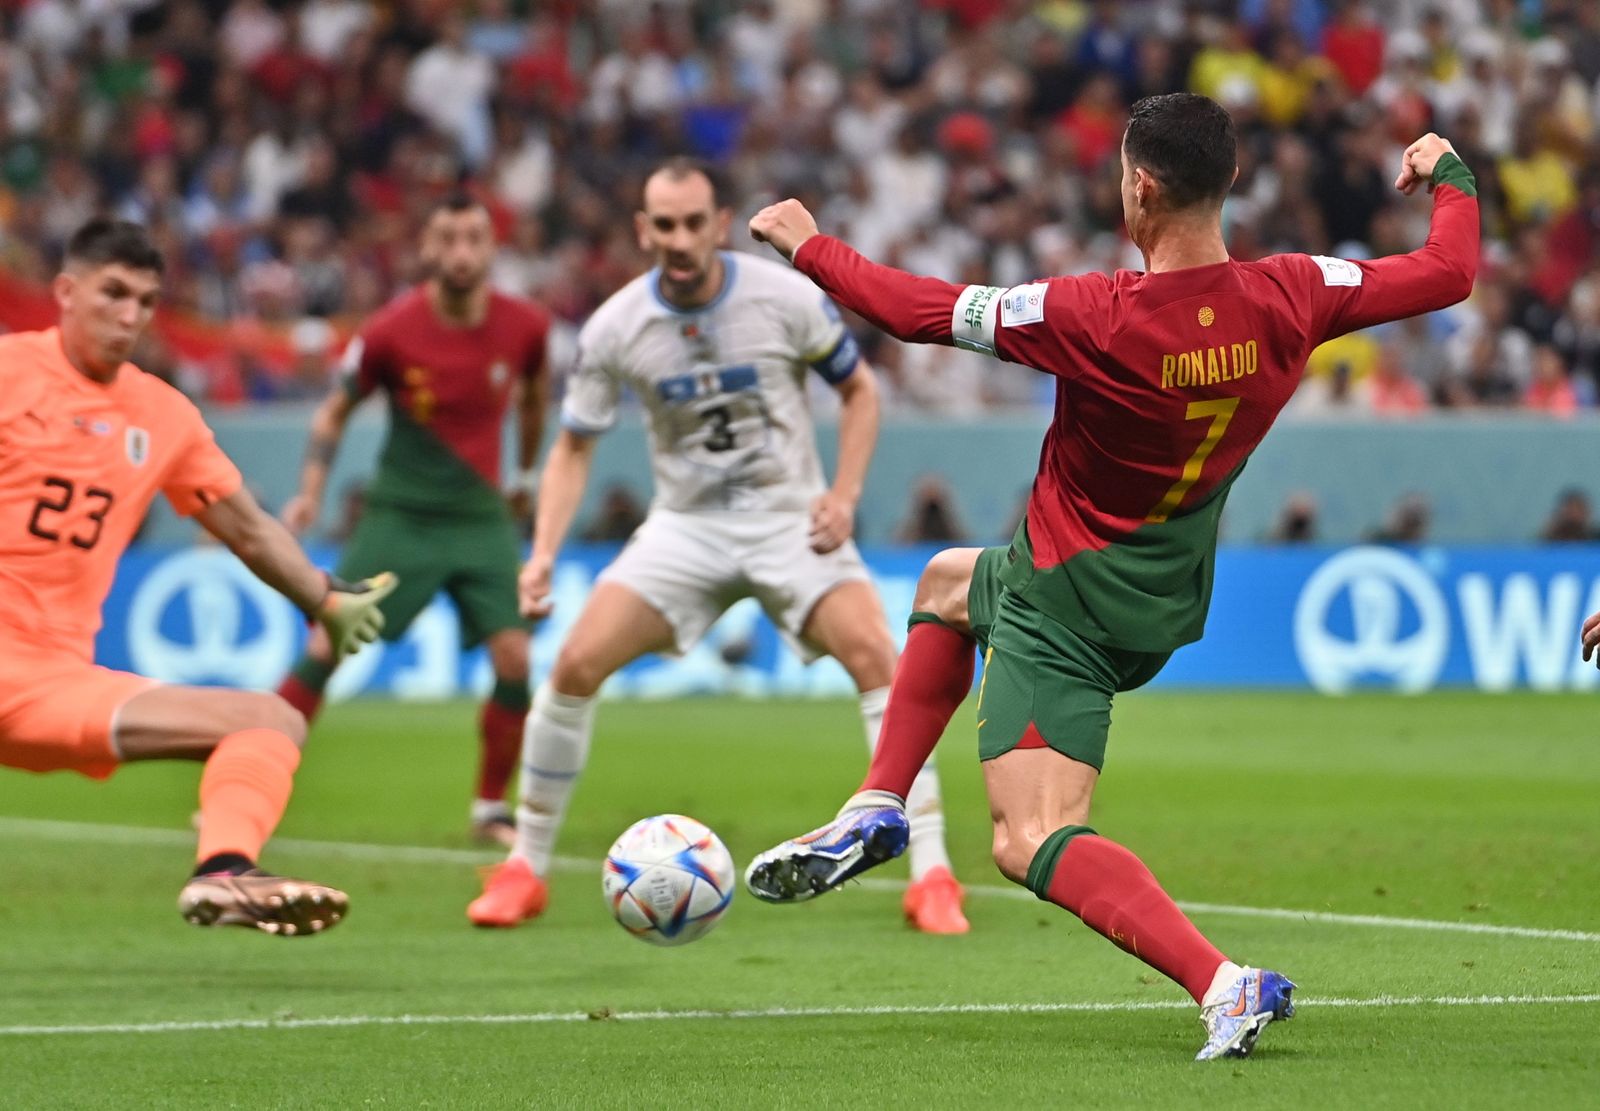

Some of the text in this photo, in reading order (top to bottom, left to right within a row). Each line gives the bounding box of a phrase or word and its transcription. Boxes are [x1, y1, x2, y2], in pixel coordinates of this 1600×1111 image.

[973, 303, 987, 328] THE
[1161, 340, 1258, 389] RONALDO
[700, 406, 735, 452] 3
[1145, 397, 1241, 524] 7
[28, 475, 115, 551] 23
